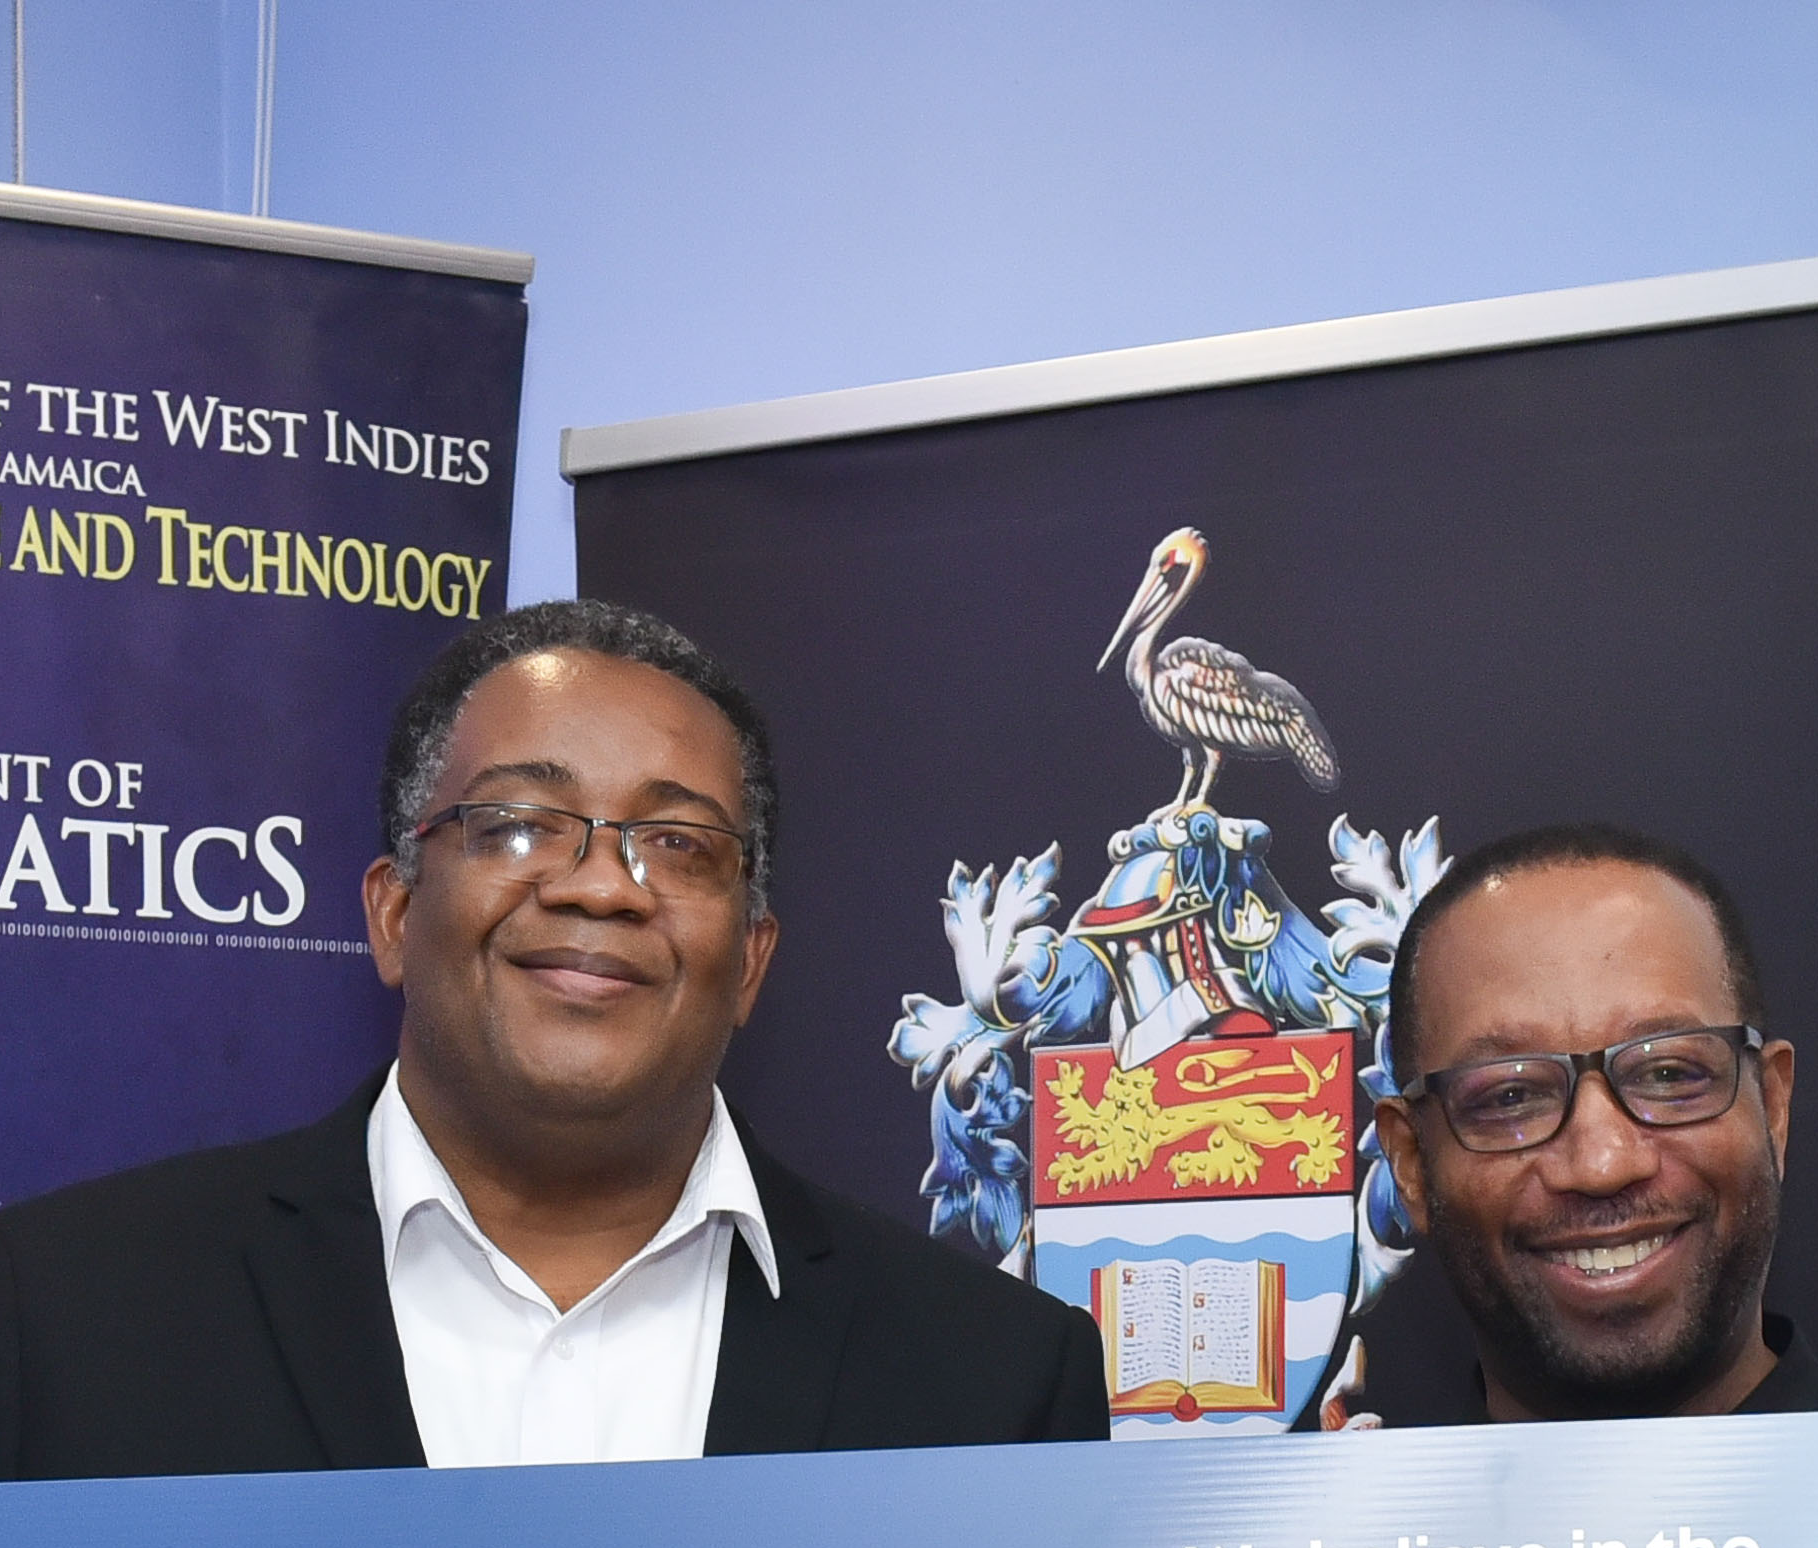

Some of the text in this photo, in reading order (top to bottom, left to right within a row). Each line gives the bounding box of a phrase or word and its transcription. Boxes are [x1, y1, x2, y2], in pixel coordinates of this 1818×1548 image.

[26, 382, 139, 443] THE
[154, 390, 306, 459] WEST
[324, 410, 490, 485] INDIES
[10, 506, 135, 581] AND
[146, 506, 491, 619] TECHNOLOGY
[68, 759, 143, 809] OF
